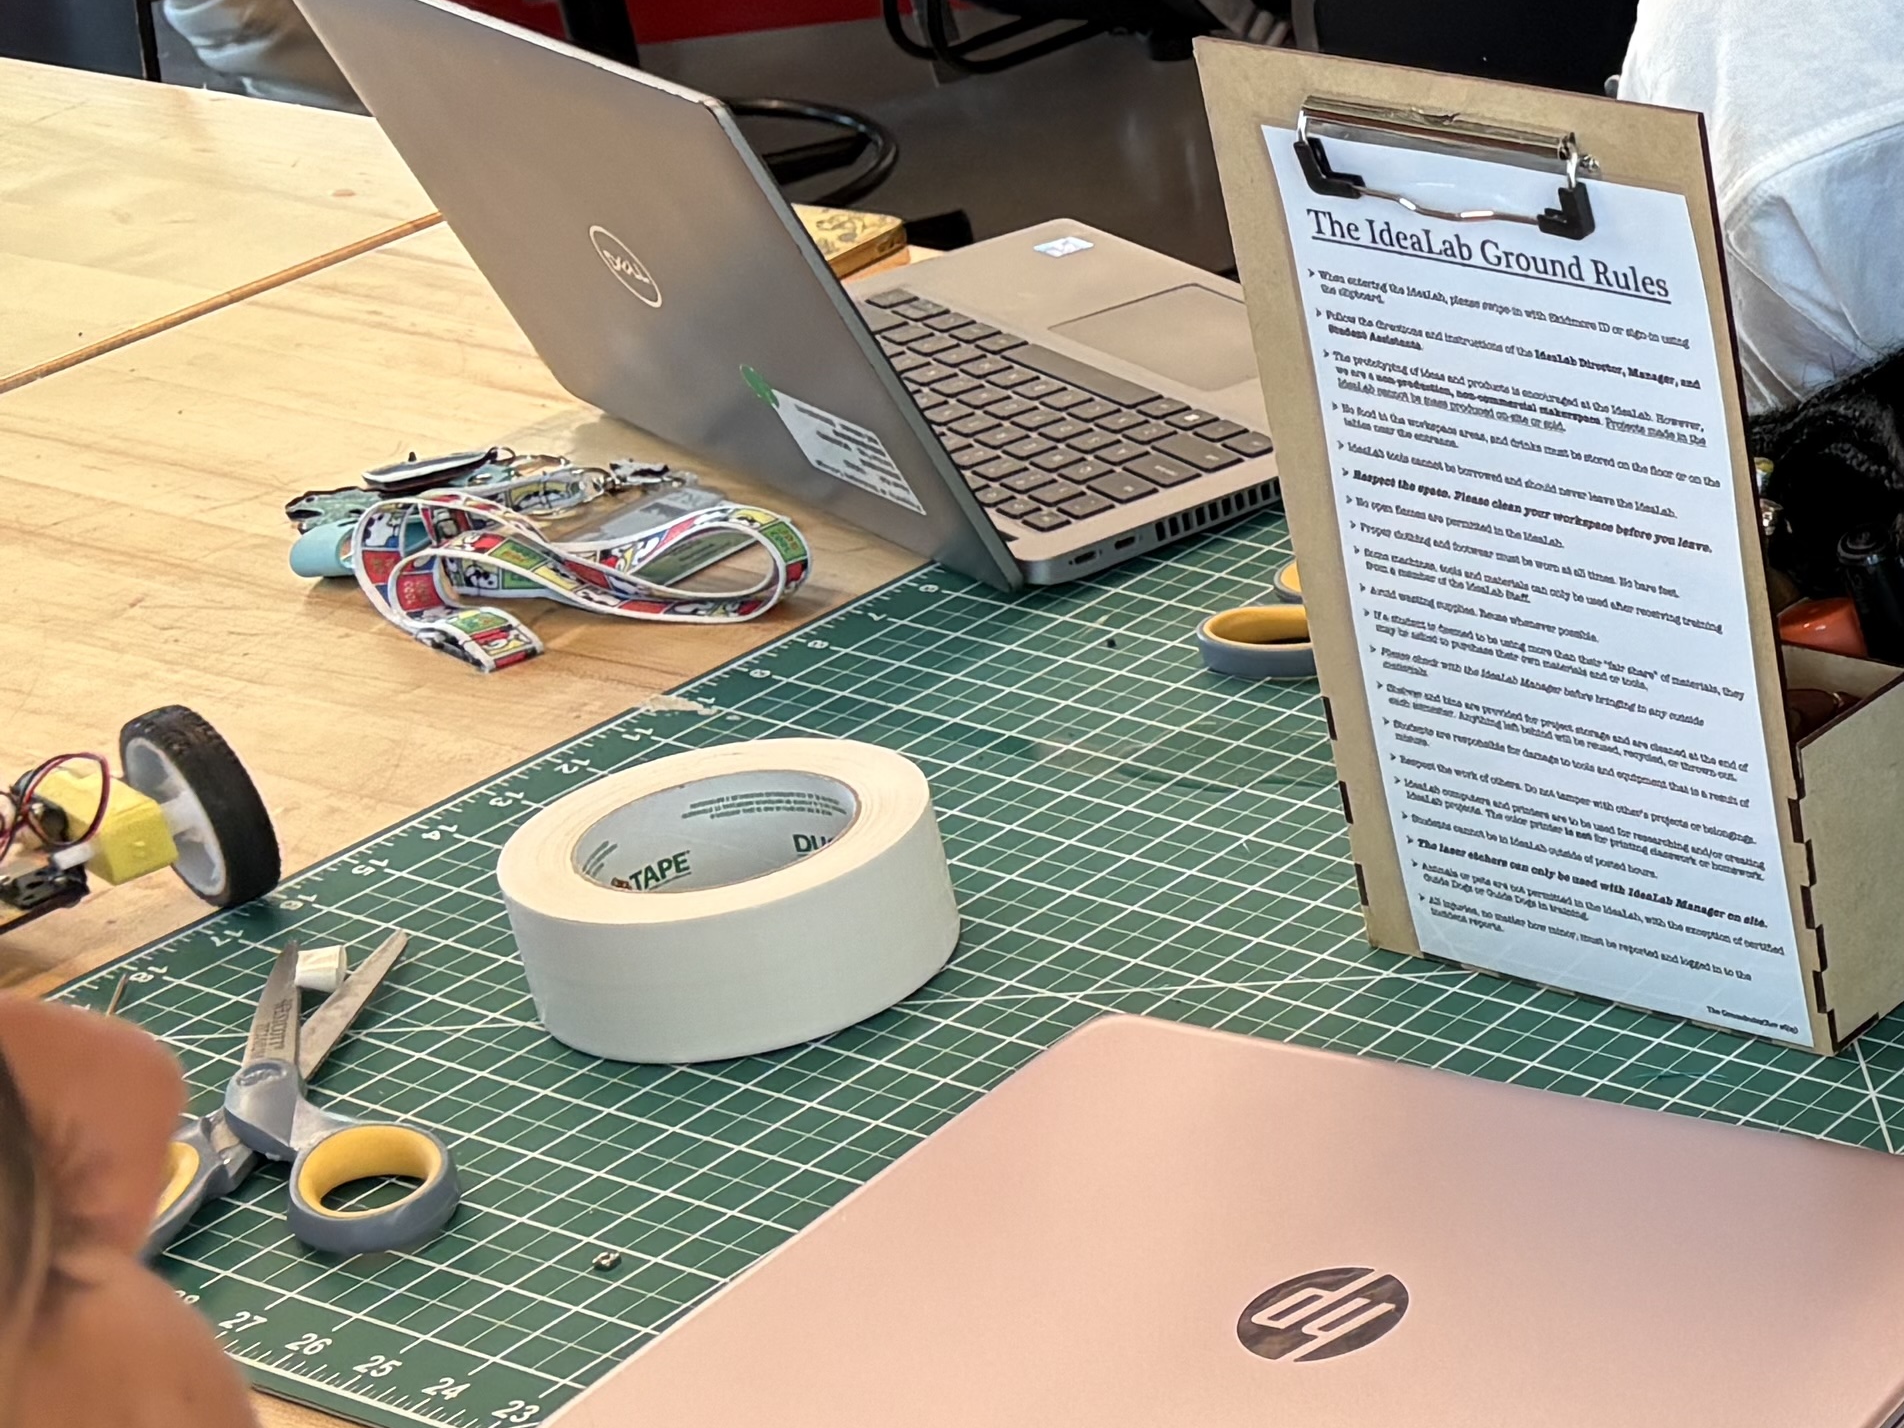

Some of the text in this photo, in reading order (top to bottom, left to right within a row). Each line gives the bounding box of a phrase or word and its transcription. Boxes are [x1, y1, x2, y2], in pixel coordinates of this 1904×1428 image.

[1306, 208, 1670, 299] The IdeaLab Ground Rules
[602, 249, 651, 285] DELL
[217, 1310, 268, 1333] 27
[284, 1332, 333, 1356] 26
[352, 1355, 403, 1378] 25
[421, 1377, 471, 1401] 24
[491, 1399, 540, 1423] 23
